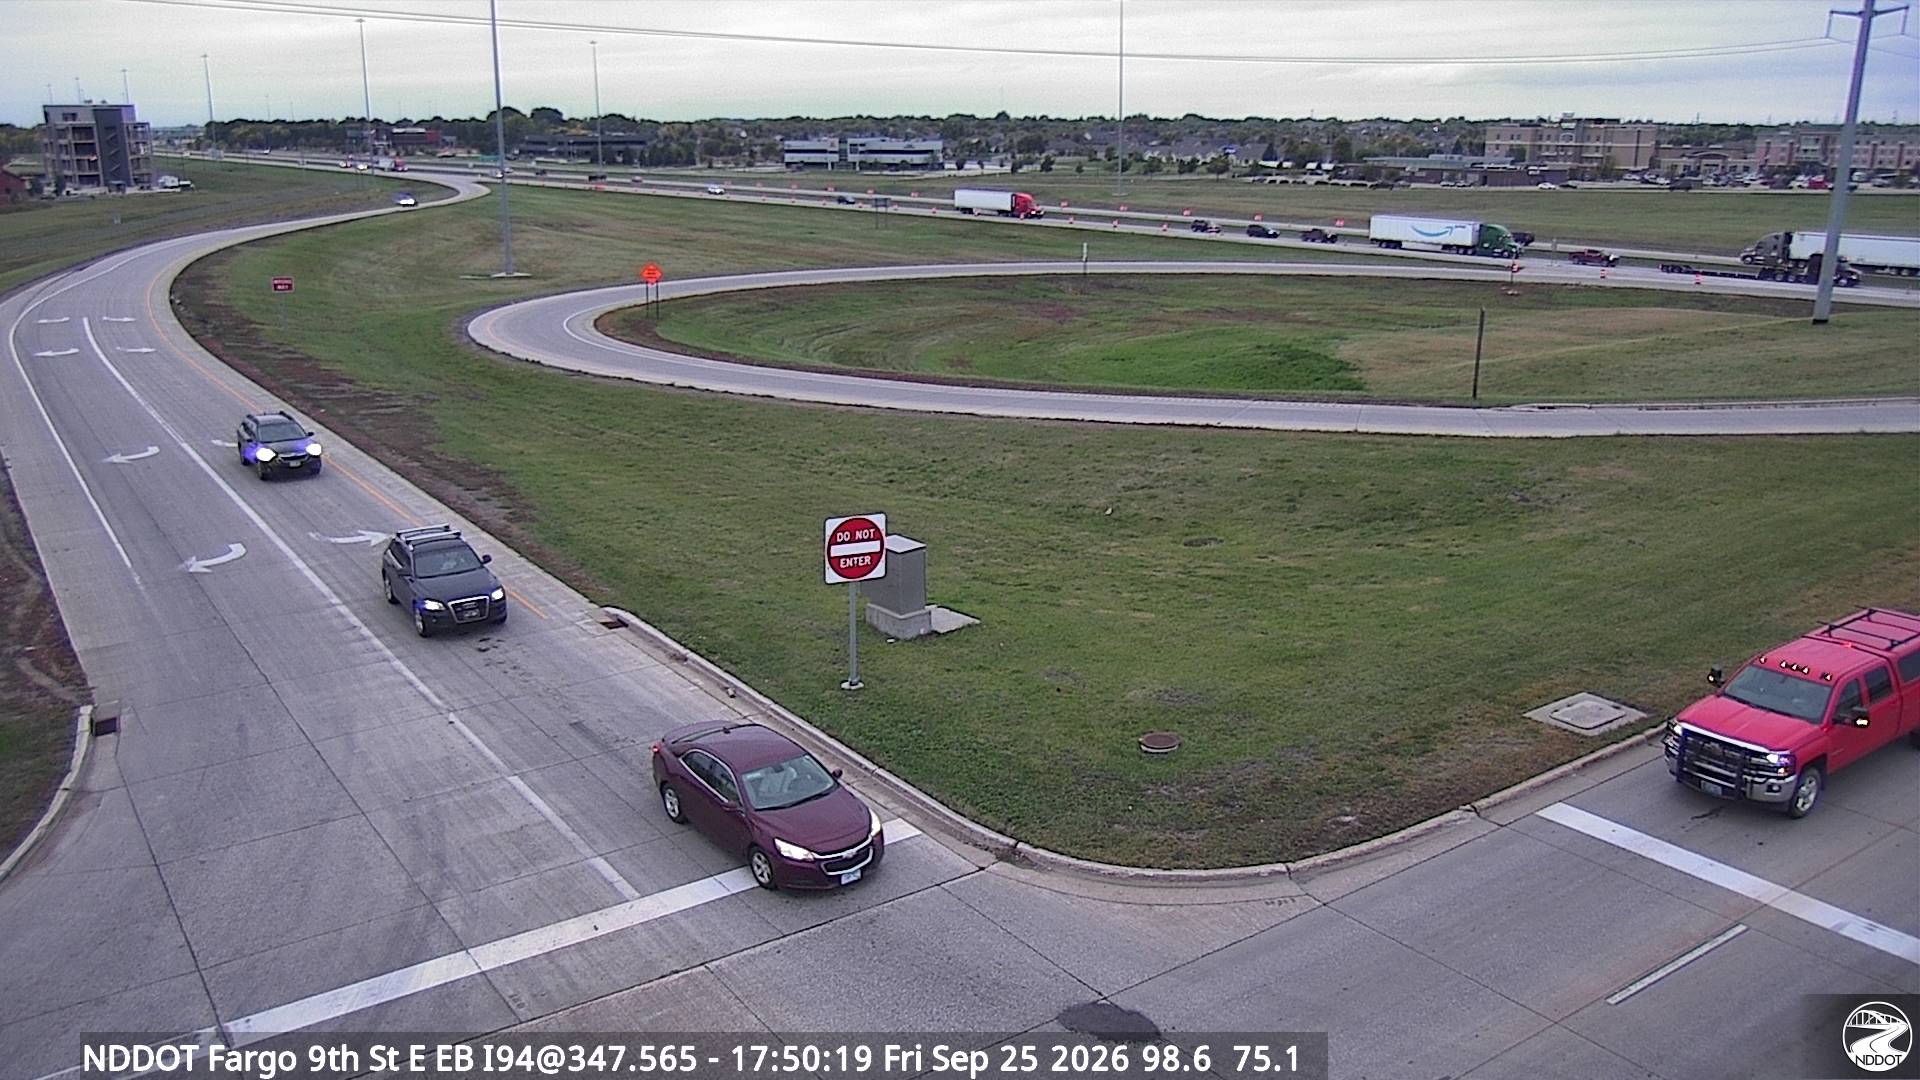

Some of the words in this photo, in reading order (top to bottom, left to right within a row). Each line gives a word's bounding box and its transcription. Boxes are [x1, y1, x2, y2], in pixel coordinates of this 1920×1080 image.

[836, 531, 851, 543] DO
[855, 528, 876, 541] NOT
[839, 555, 872, 569] ENTER
